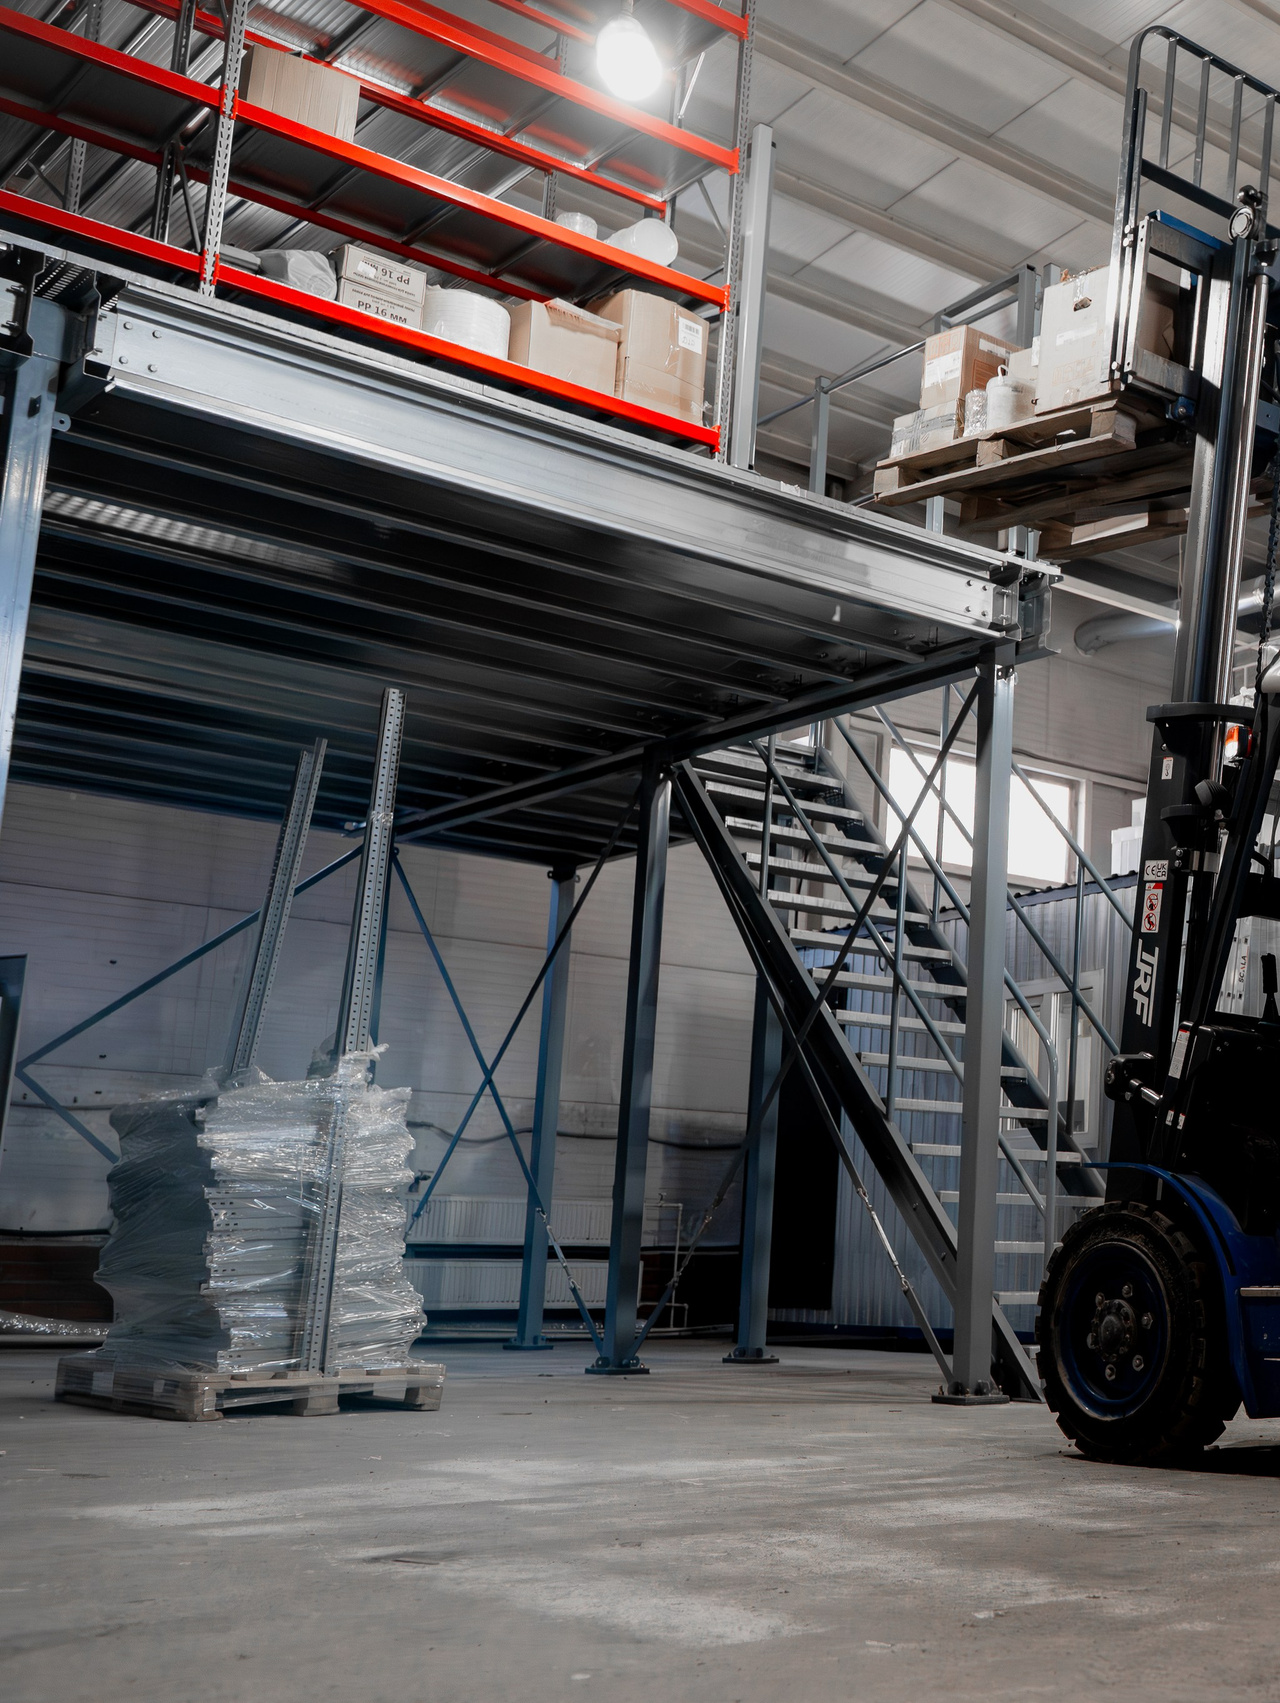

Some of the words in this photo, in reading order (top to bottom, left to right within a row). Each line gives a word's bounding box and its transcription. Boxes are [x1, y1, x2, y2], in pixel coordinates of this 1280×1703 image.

[381, 267, 394, 279] 16
[374, 306, 387, 317] 16
[1145, 865, 1156, 876] CE
[1133, 938, 1159, 1028] TRF
